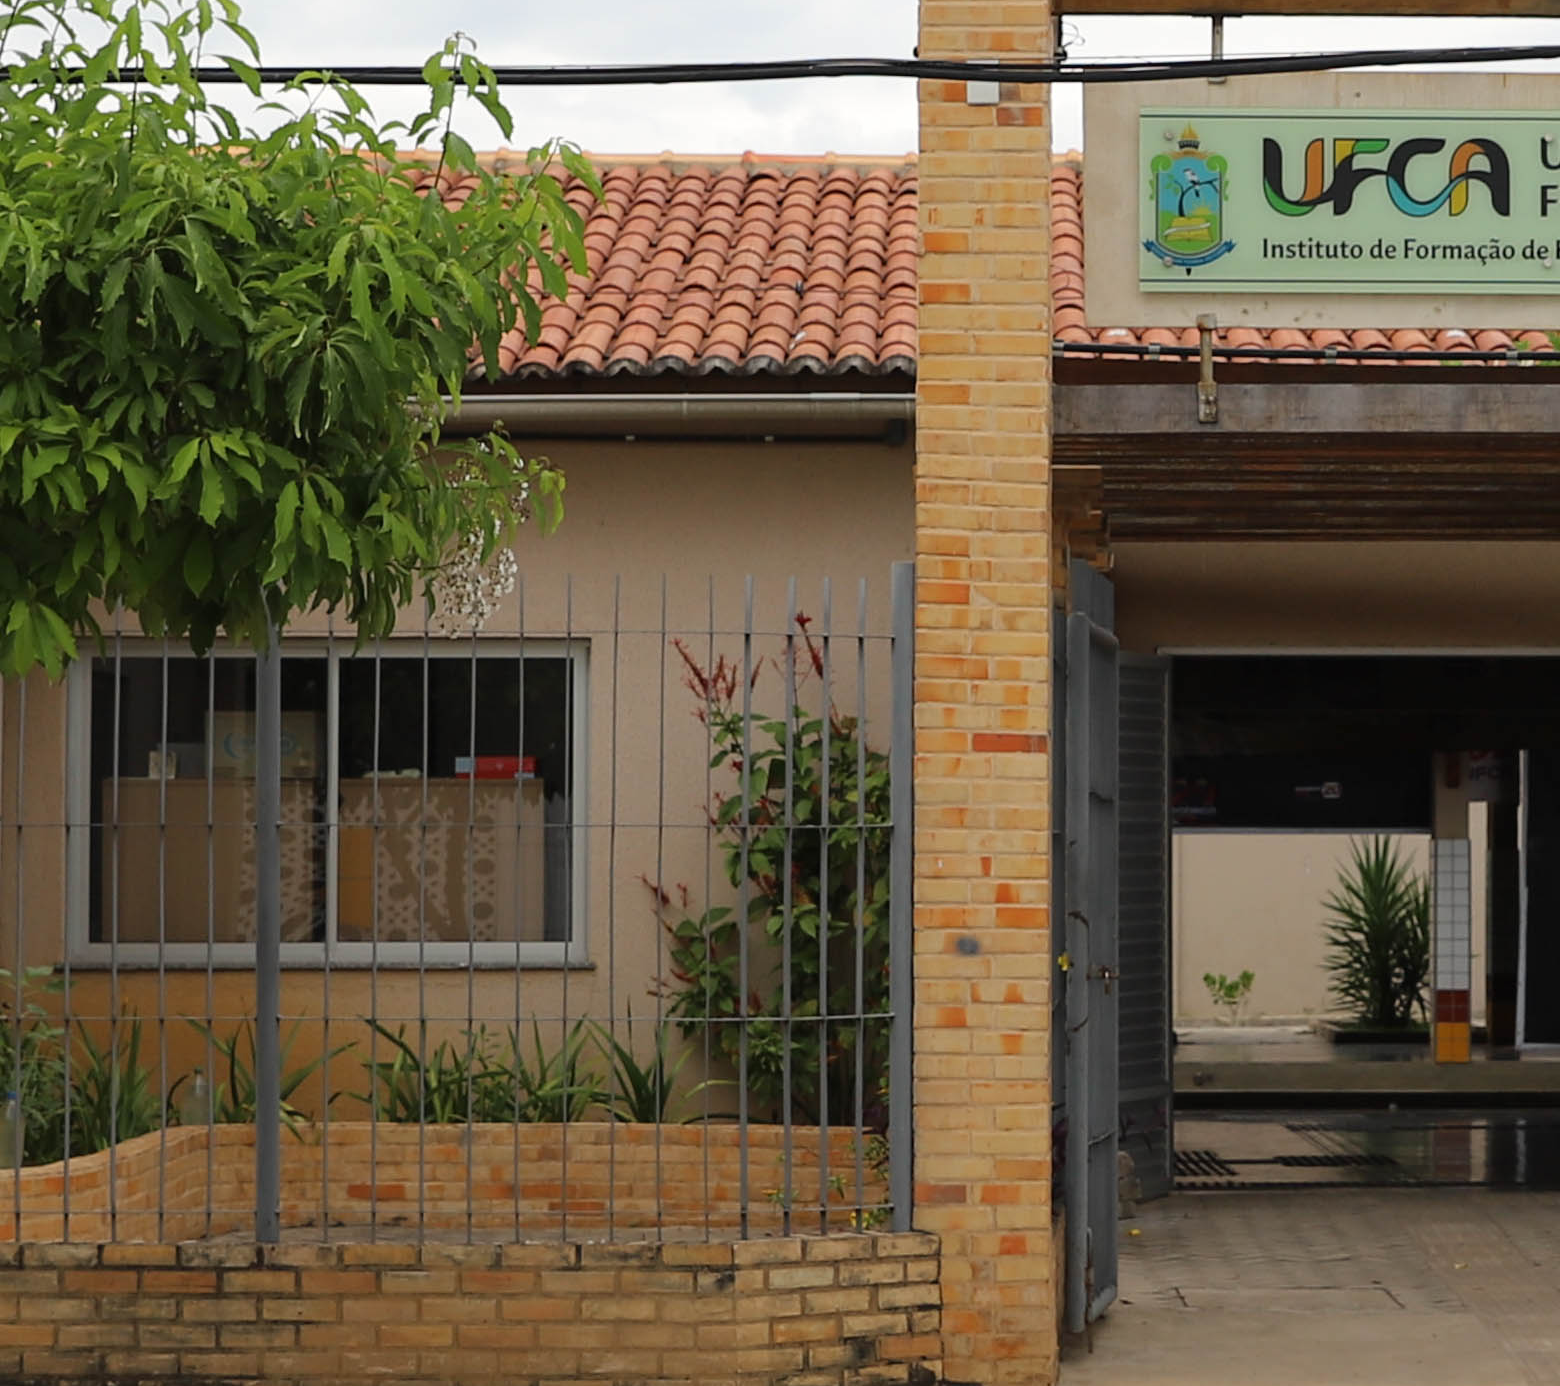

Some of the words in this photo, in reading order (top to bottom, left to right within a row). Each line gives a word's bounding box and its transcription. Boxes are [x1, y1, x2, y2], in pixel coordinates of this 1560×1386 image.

[1262, 137, 1511, 217] UFCA
[1262, 238, 1364, 261] Instituto
[1369, 238, 1397, 261] de
[1403, 238, 1516, 267] Formação
[1521, 238, 1549, 261] de
